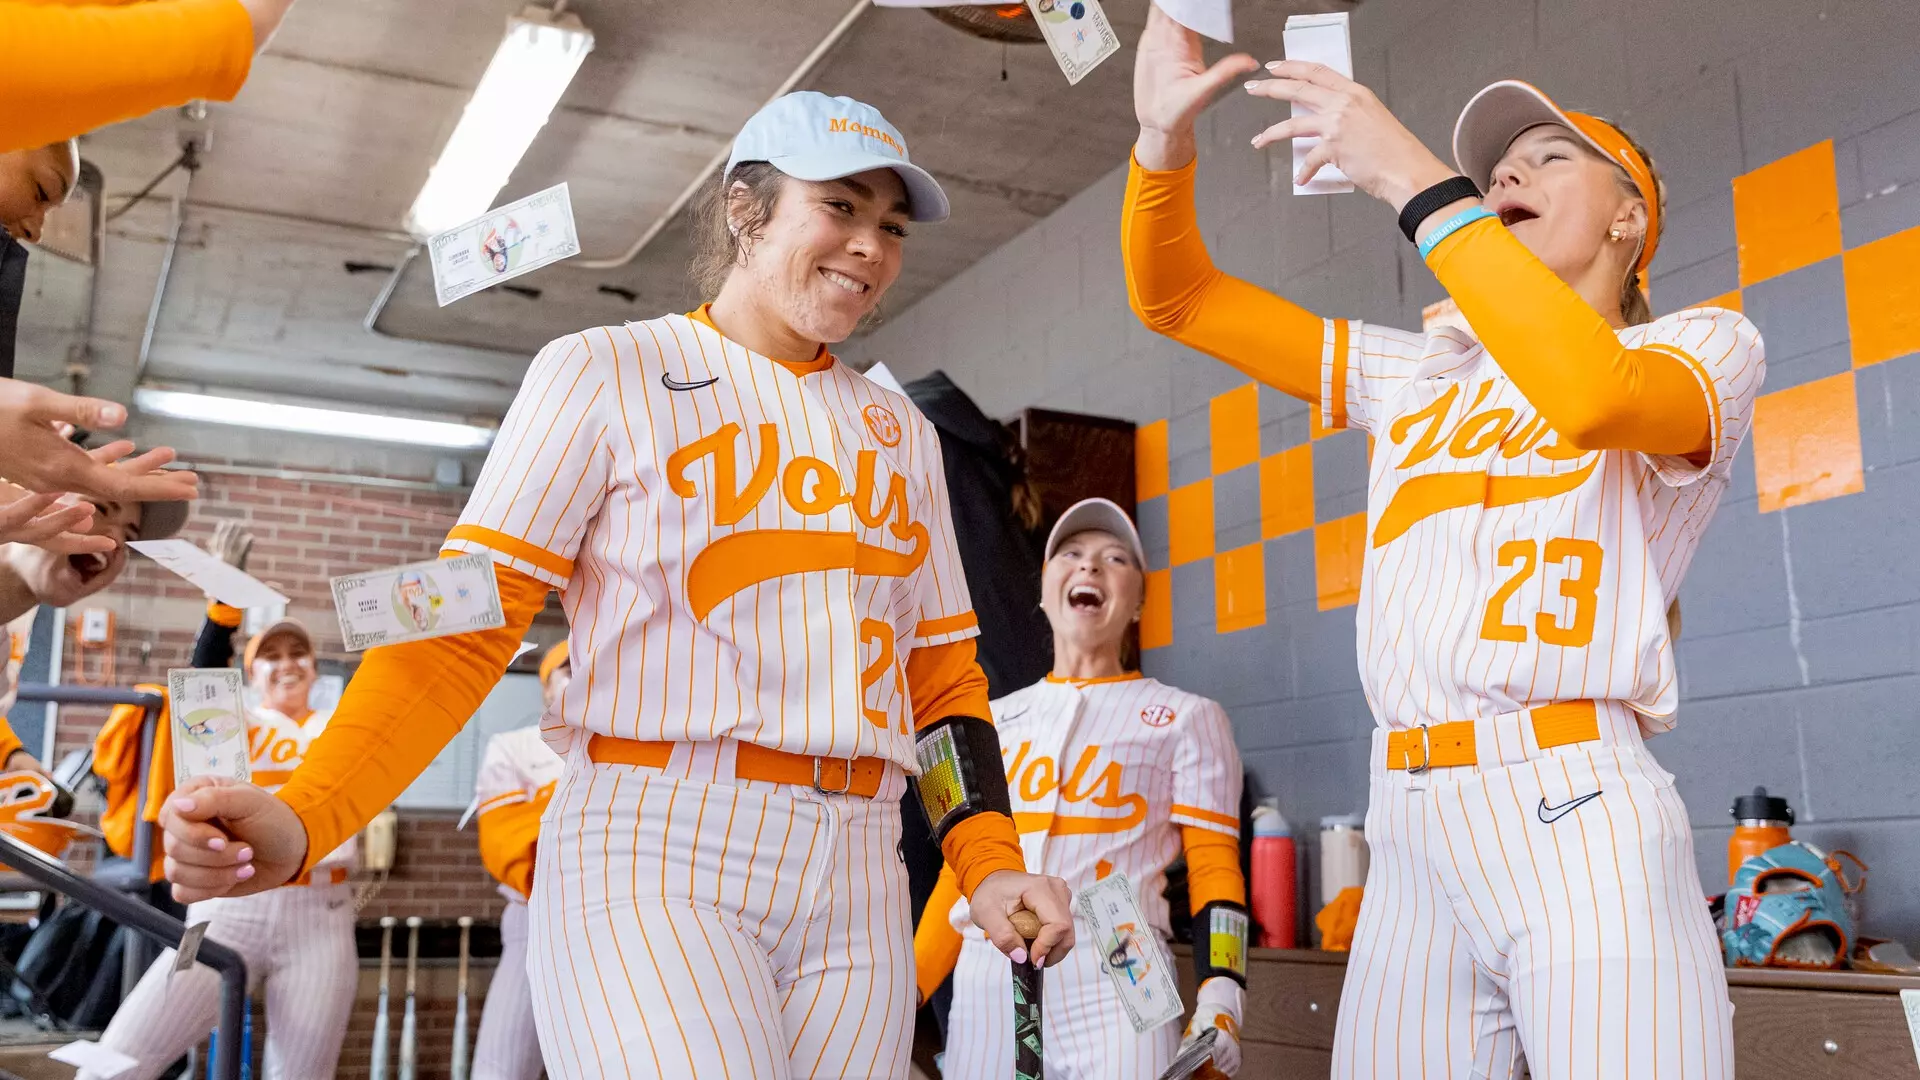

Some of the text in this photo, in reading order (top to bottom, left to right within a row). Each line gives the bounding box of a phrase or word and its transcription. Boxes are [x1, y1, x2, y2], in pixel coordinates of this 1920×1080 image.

[829, 117, 904, 156] Mommy
[1425, 217, 1463, 247] Ubuntu
[666, 421, 929, 547] Vols
[1480, 537, 1604, 648] 23
[860, 617, 908, 735] 2
